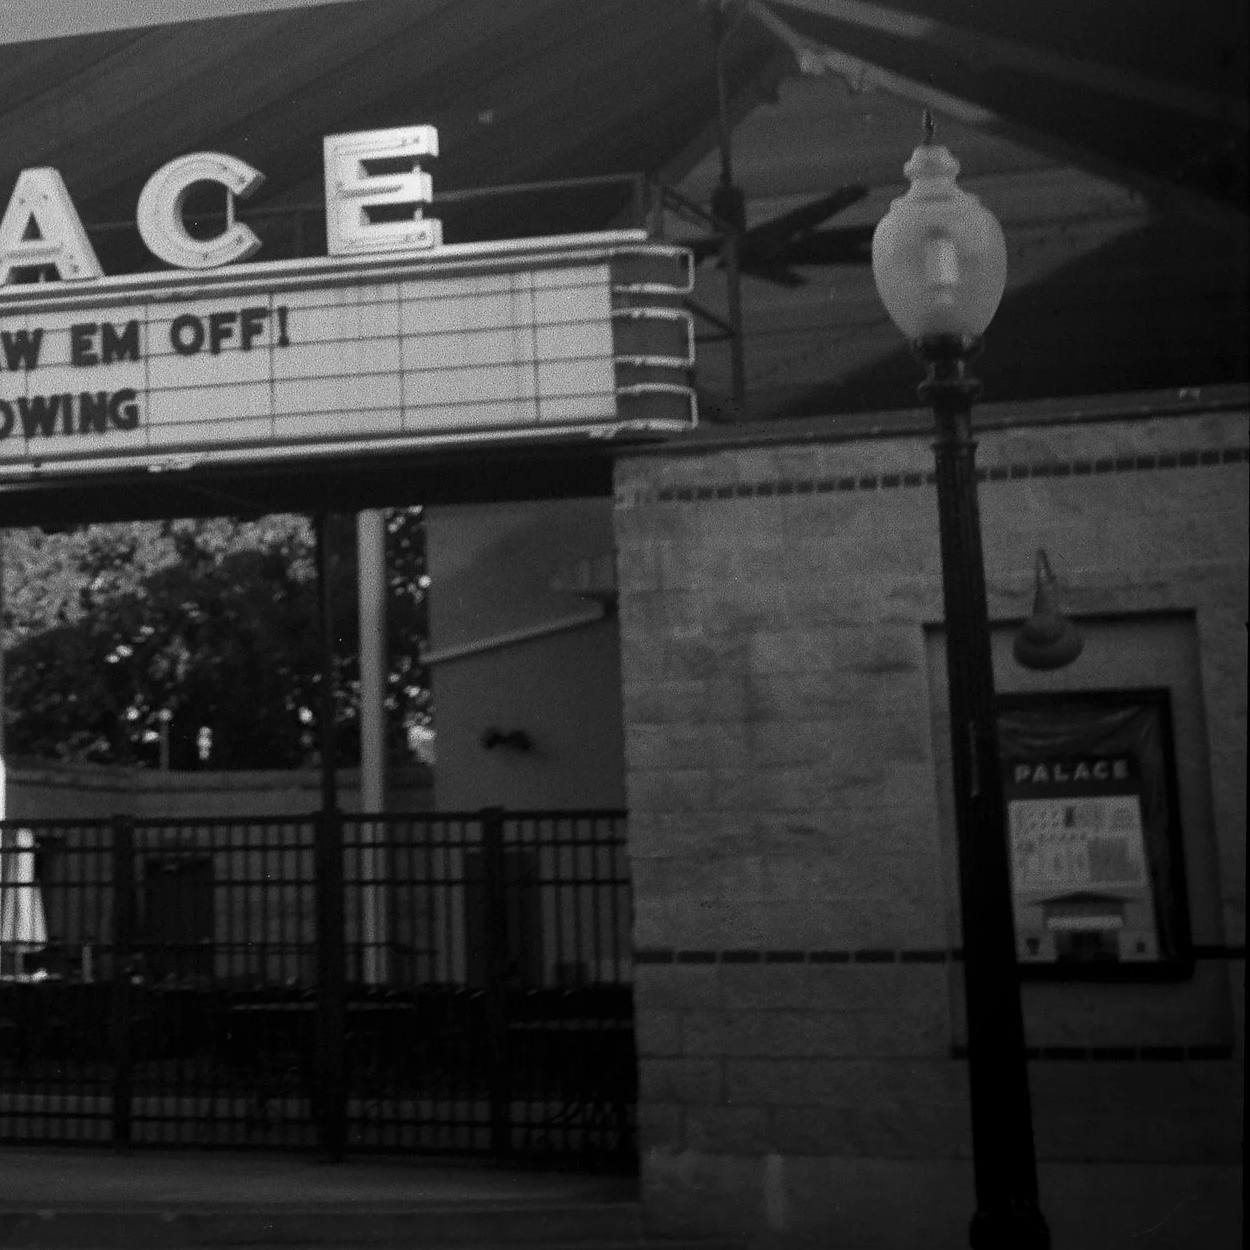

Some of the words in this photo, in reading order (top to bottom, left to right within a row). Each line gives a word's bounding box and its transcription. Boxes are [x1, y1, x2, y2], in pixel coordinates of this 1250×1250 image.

[70, 319, 140, 366] EM
[170, 306, 290, 356] OFF!
[1014, 760, 1128, 783] PALACE
